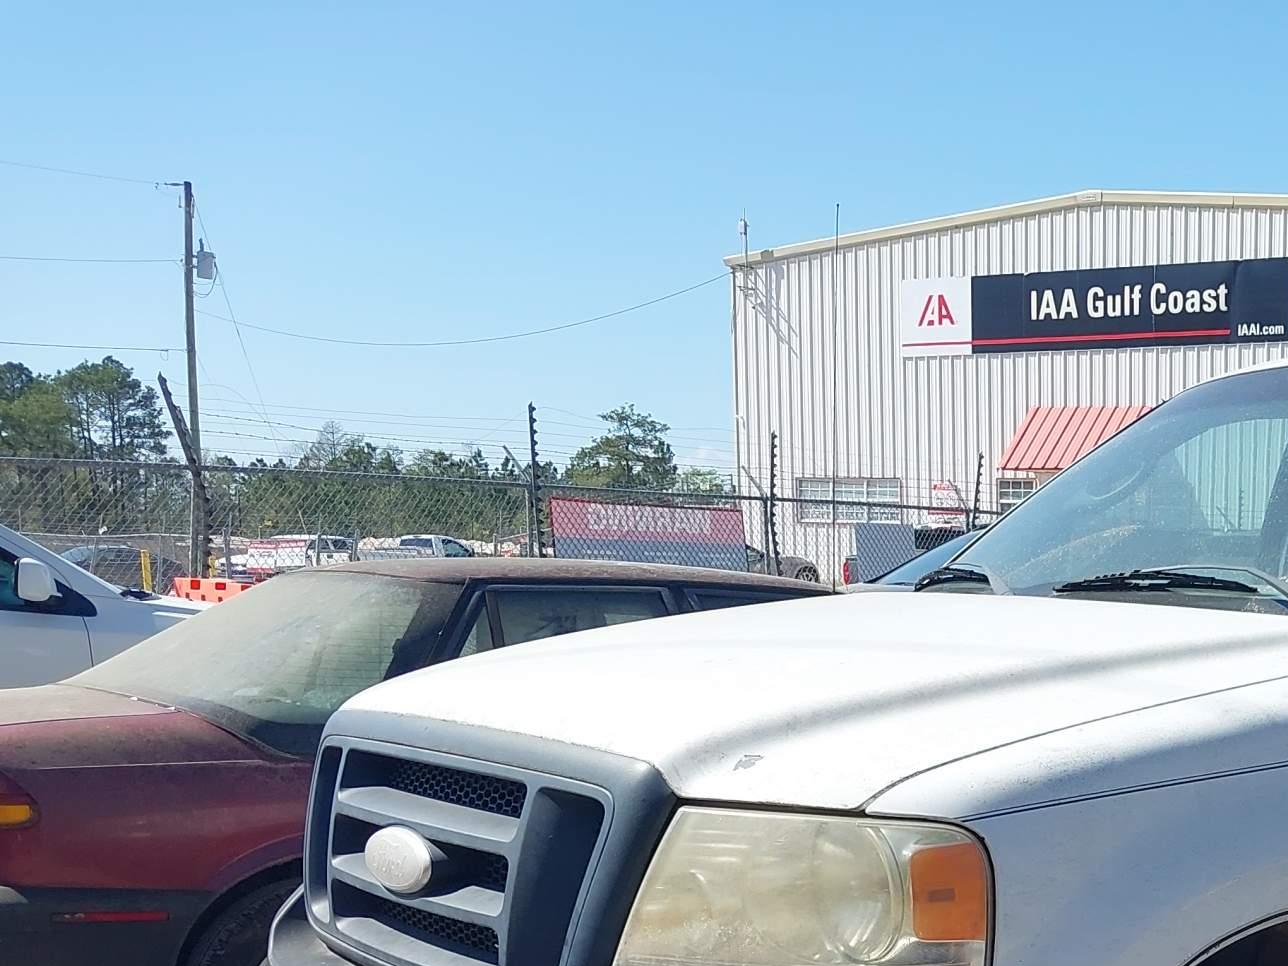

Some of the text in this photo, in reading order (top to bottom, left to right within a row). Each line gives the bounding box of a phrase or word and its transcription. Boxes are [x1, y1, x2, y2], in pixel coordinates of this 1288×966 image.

[1030, 282, 1229, 321] IAA Gulf Coast
[1237, 322, 1285, 337] IAAI.com
